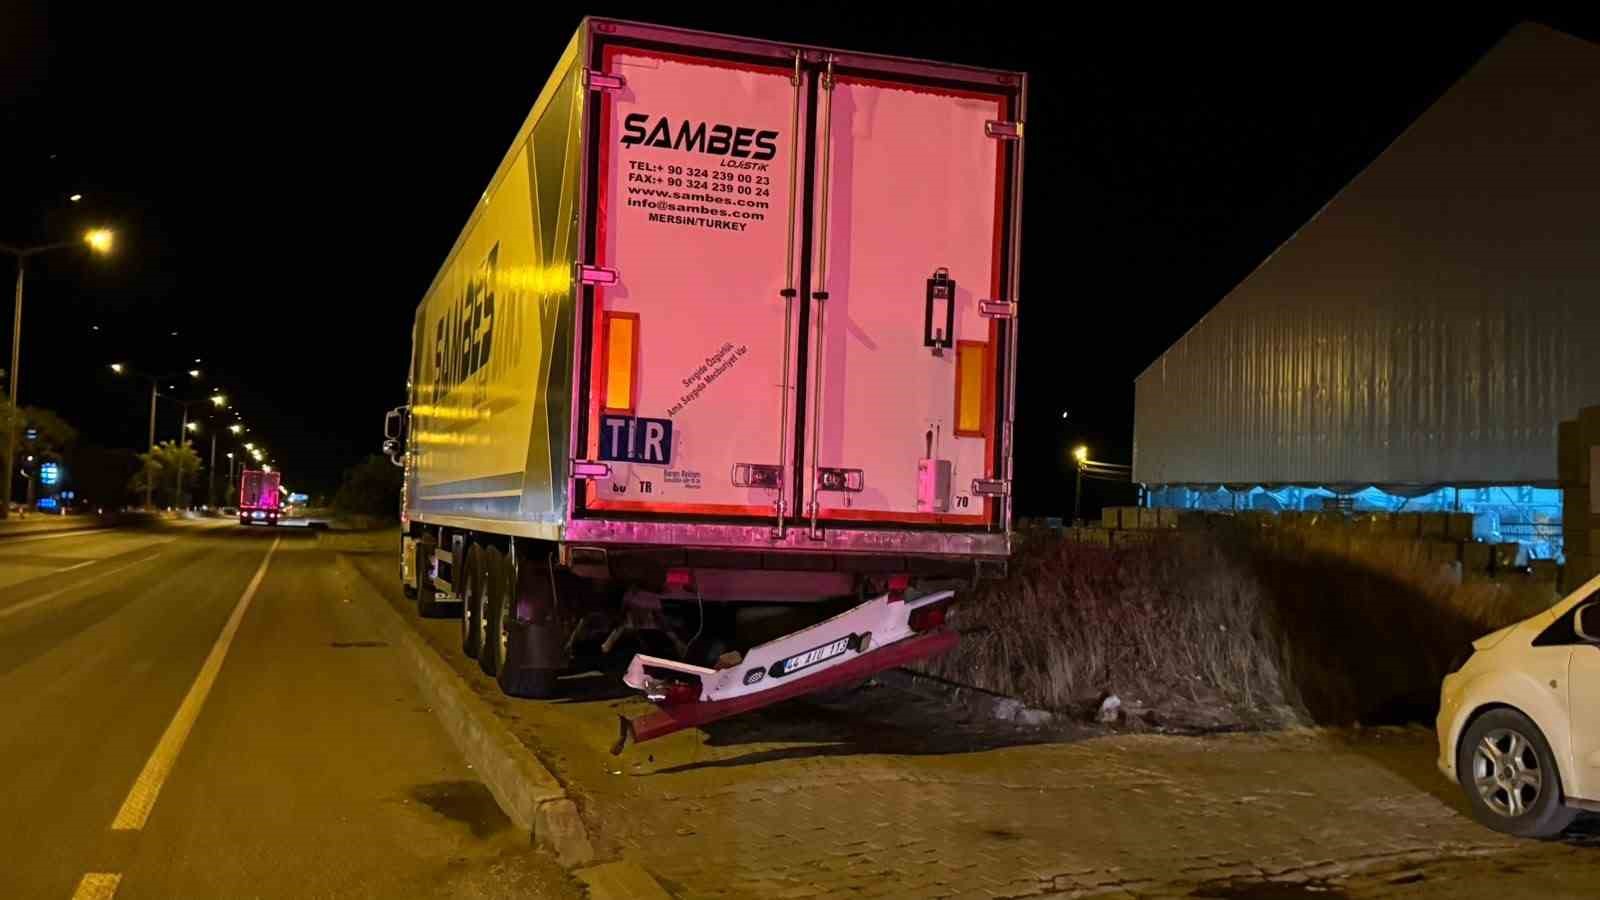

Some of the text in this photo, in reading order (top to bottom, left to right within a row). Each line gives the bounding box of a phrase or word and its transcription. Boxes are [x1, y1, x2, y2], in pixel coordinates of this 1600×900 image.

[668, 165, 682, 175] 90
[686, 167, 708, 178] 324
[712, 170, 734, 181] 239
[737, 173, 751, 183] 00
[756, 176, 770, 186] 23
[668, 177, 682, 187] 90
[686, 179, 708, 190] 324
[712, 182, 734, 193] 239
[737, 185, 751, 195] 00
[755, 188, 770, 197] 24
[628, 187, 769, 209] www.sambes.com
[627, 197, 765, 221] info@sambes.com
[605, 418, 665, 461] TIR
[640, 481, 652, 493] TR
[956, 496, 968, 508] 70
